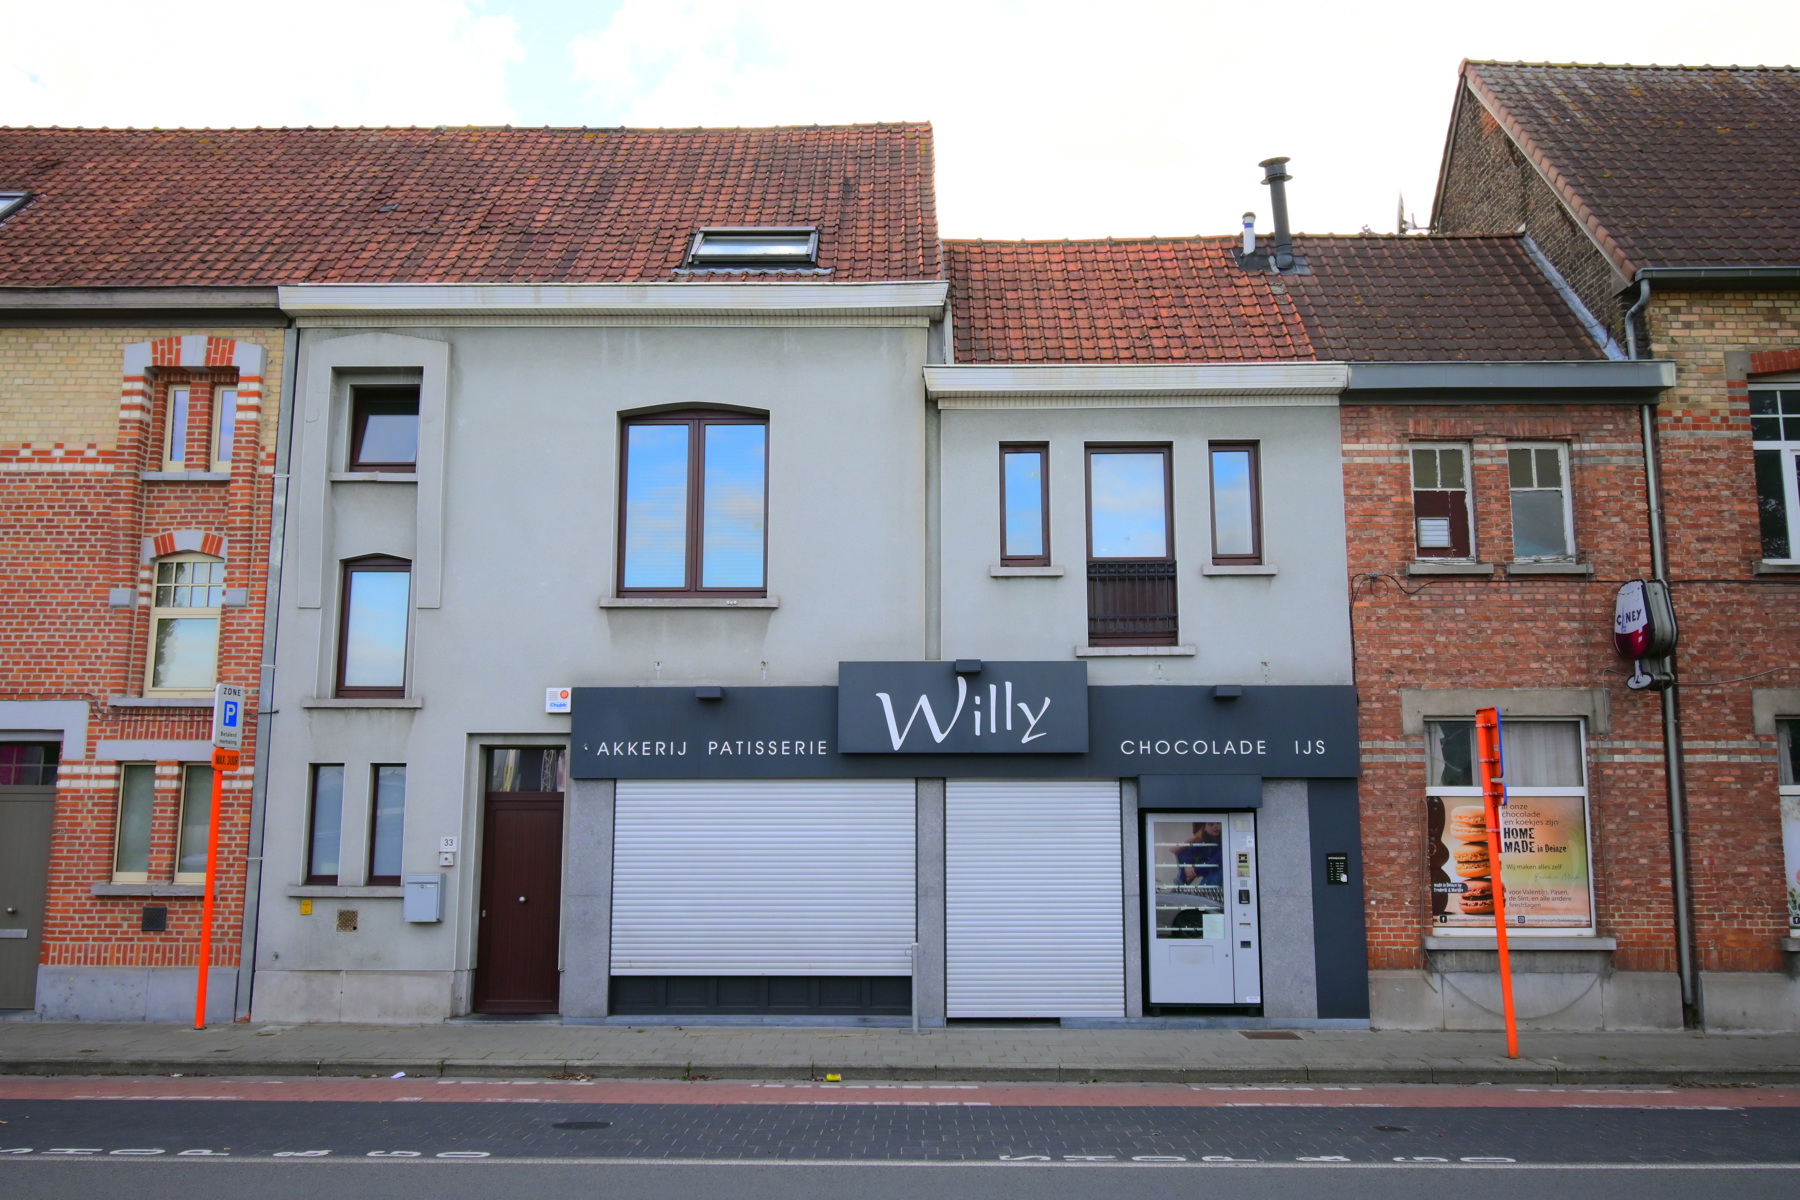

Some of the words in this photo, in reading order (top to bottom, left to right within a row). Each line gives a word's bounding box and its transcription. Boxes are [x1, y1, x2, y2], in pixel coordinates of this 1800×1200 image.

[1616, 608, 1642, 627] CINEY
[223, 687, 241, 697] ZONE
[225, 703, 236, 724] P
[875, 676, 1051, 751] Willy
[597, 741, 687, 756] AKKERIJ
[708, 740, 827, 755] PATISSERIE
[1120, 740, 1267, 755] CHOCOLADE
[1295, 740, 1326, 755] IJS
[1515, 818, 1544, 826] koekjes
[1545, 818, 1559, 826] zijn
[1503, 827, 1535, 840] HOME
[443, 838, 454, 847] 33
[1504, 840, 1536, 853] MADE
[1544, 844, 1567, 853] Deinze
[1508, 901, 1542, 909] feestdagen
